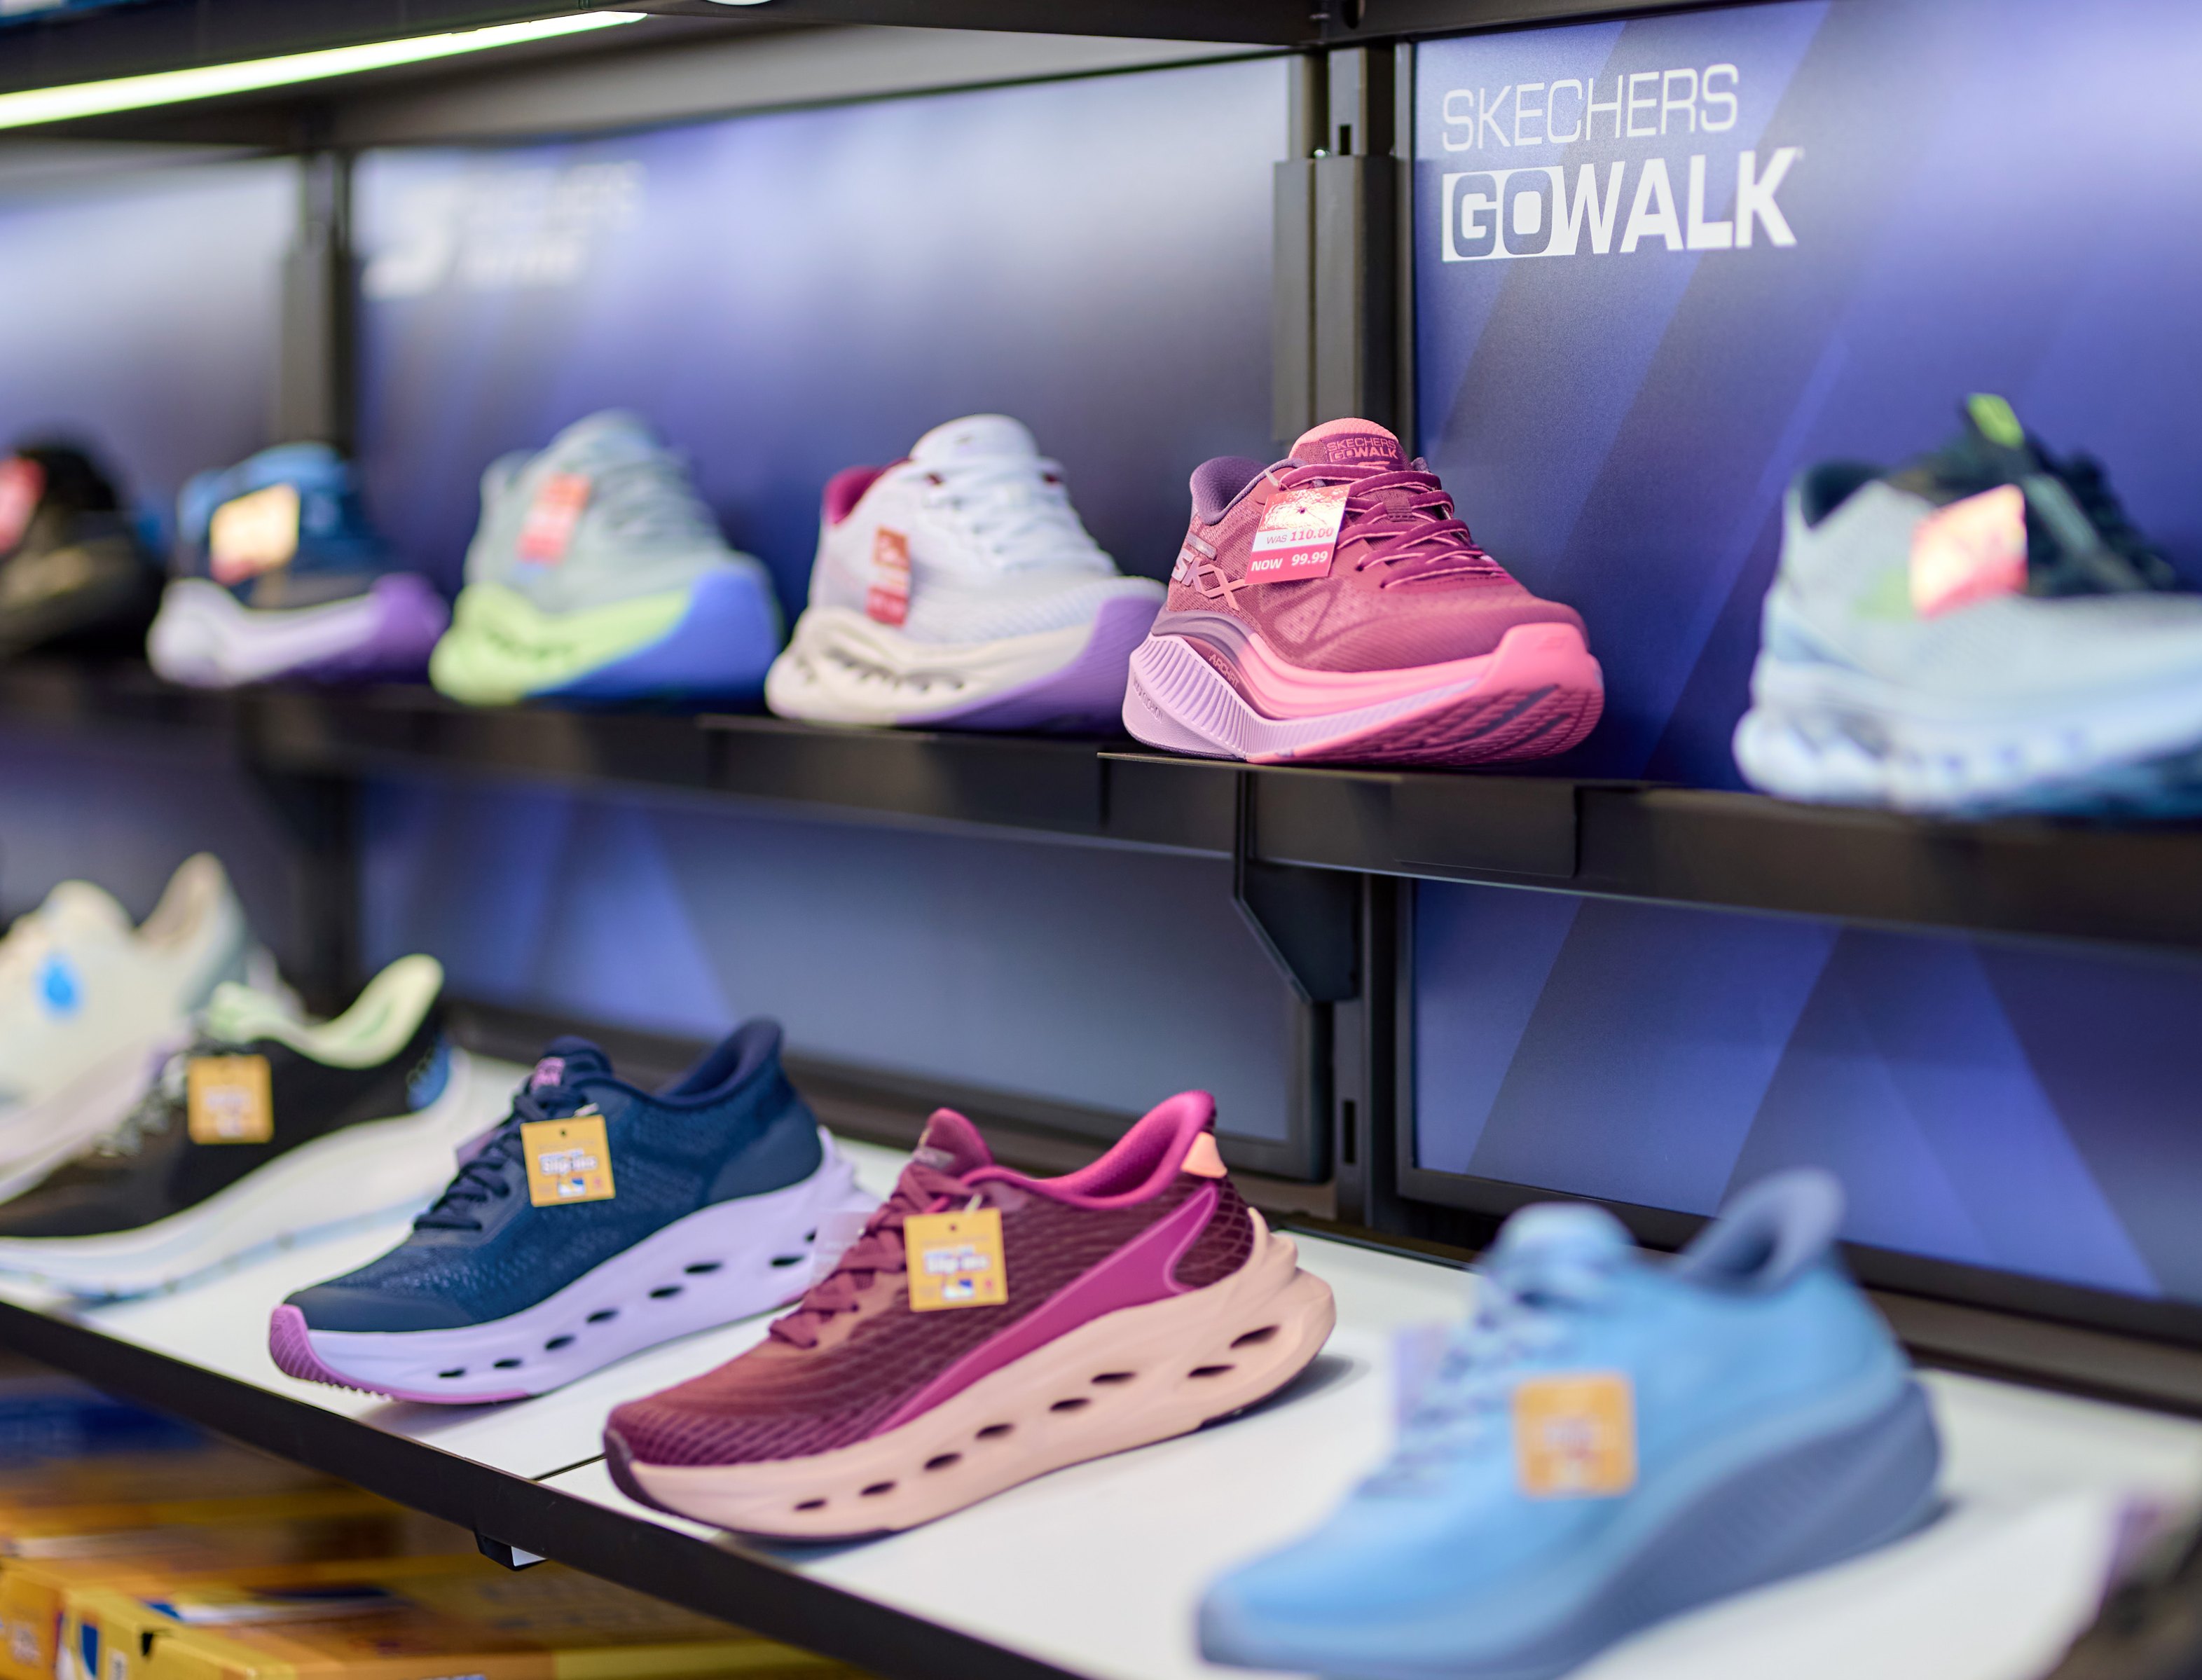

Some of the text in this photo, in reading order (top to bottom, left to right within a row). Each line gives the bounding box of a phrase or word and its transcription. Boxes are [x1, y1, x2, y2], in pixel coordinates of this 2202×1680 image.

[1442, 63, 1739, 152] SKECHERS
[1326, 436, 1396, 452] SKECHERS
[1267, 527, 1334, 545] WAS 110.00
[1251, 551, 1328, 572] NOW 99.99
